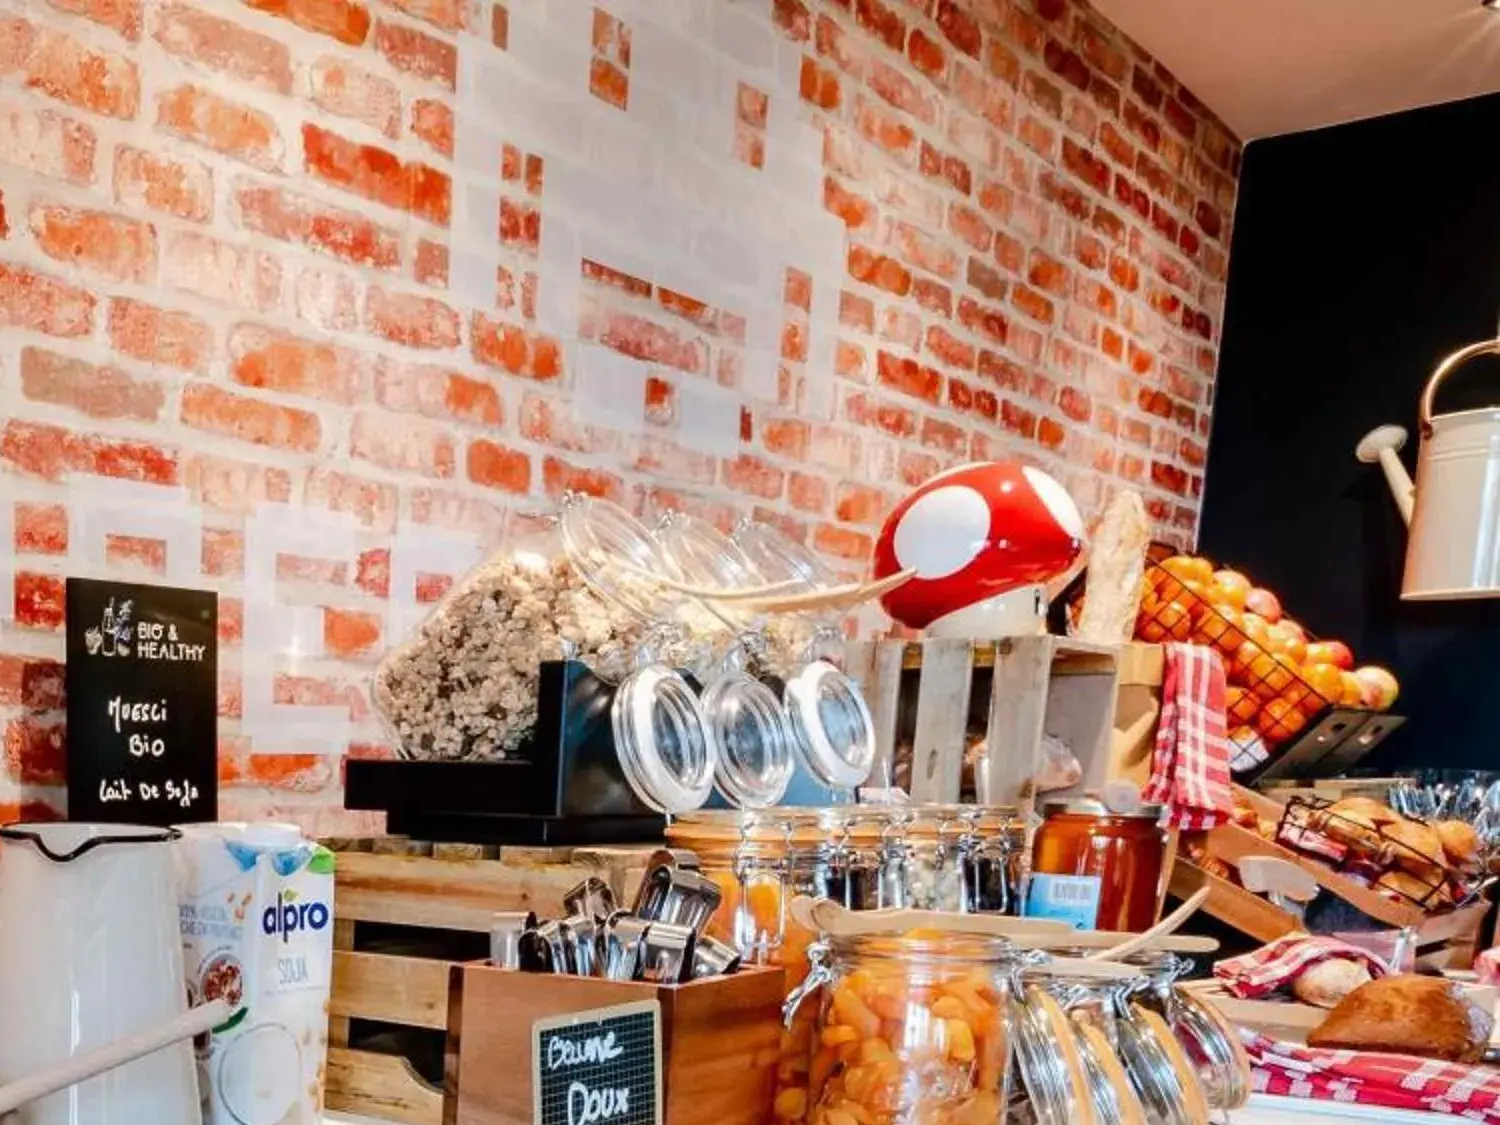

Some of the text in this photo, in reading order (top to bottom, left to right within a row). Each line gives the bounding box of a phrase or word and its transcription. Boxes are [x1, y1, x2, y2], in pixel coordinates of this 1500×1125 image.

[168, 624, 179, 641] &
[138, 641, 206, 661] HEALTHY
[263, 891, 329, 943] alpro
